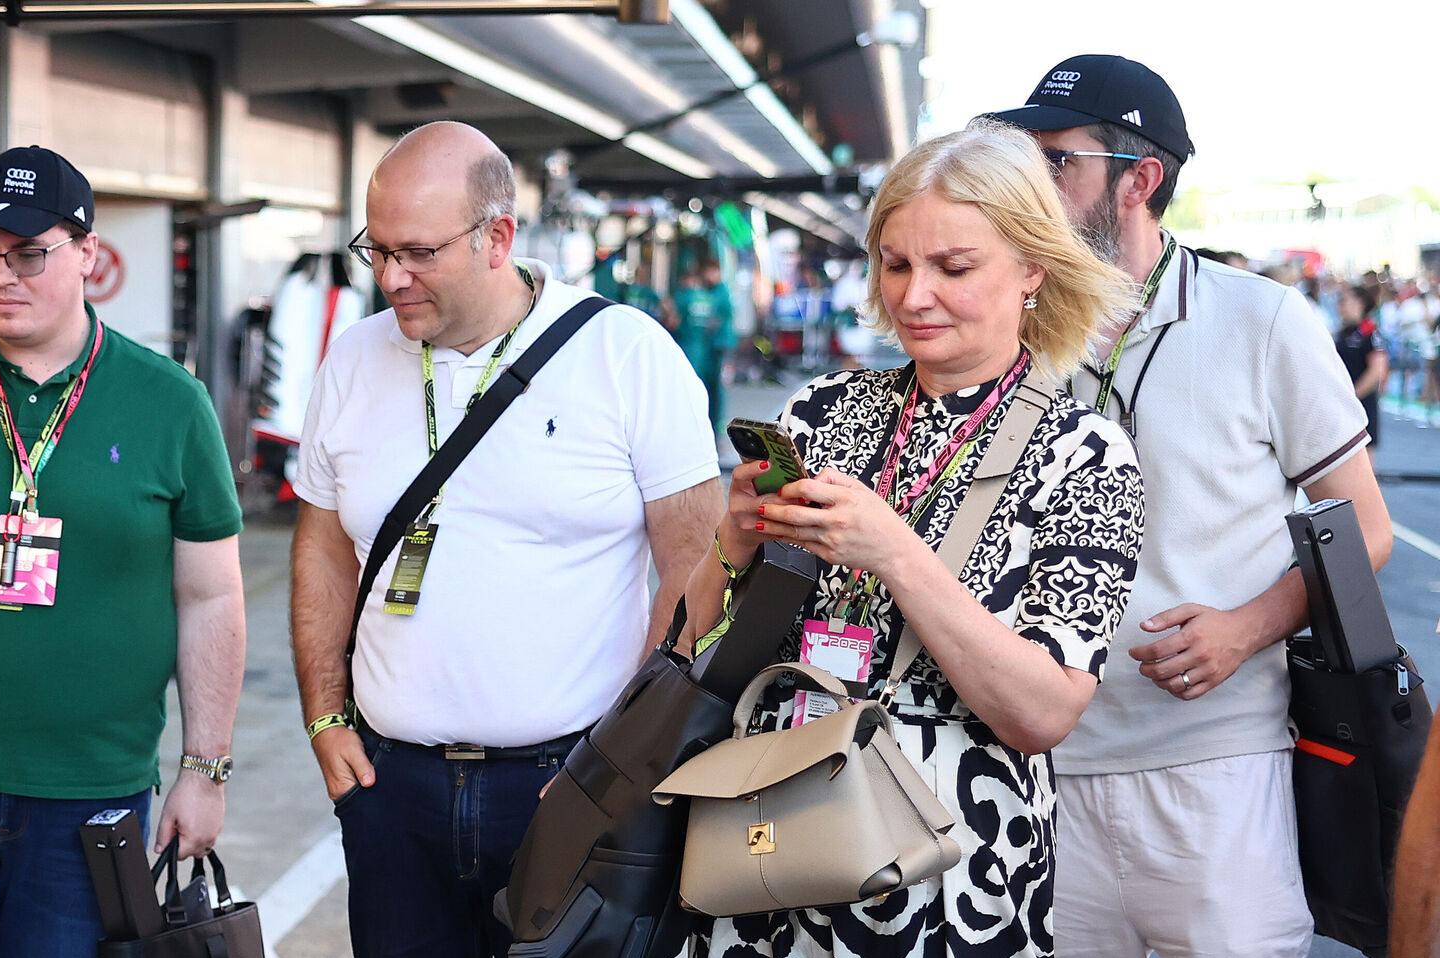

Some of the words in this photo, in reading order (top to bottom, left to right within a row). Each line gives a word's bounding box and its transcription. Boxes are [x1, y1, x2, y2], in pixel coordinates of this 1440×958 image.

[951, 428, 967, 445] VIP
[966, 402, 992, 430] 2026
[804, 631, 829, 648] VIP
[828, 636, 871, 654] 2026
